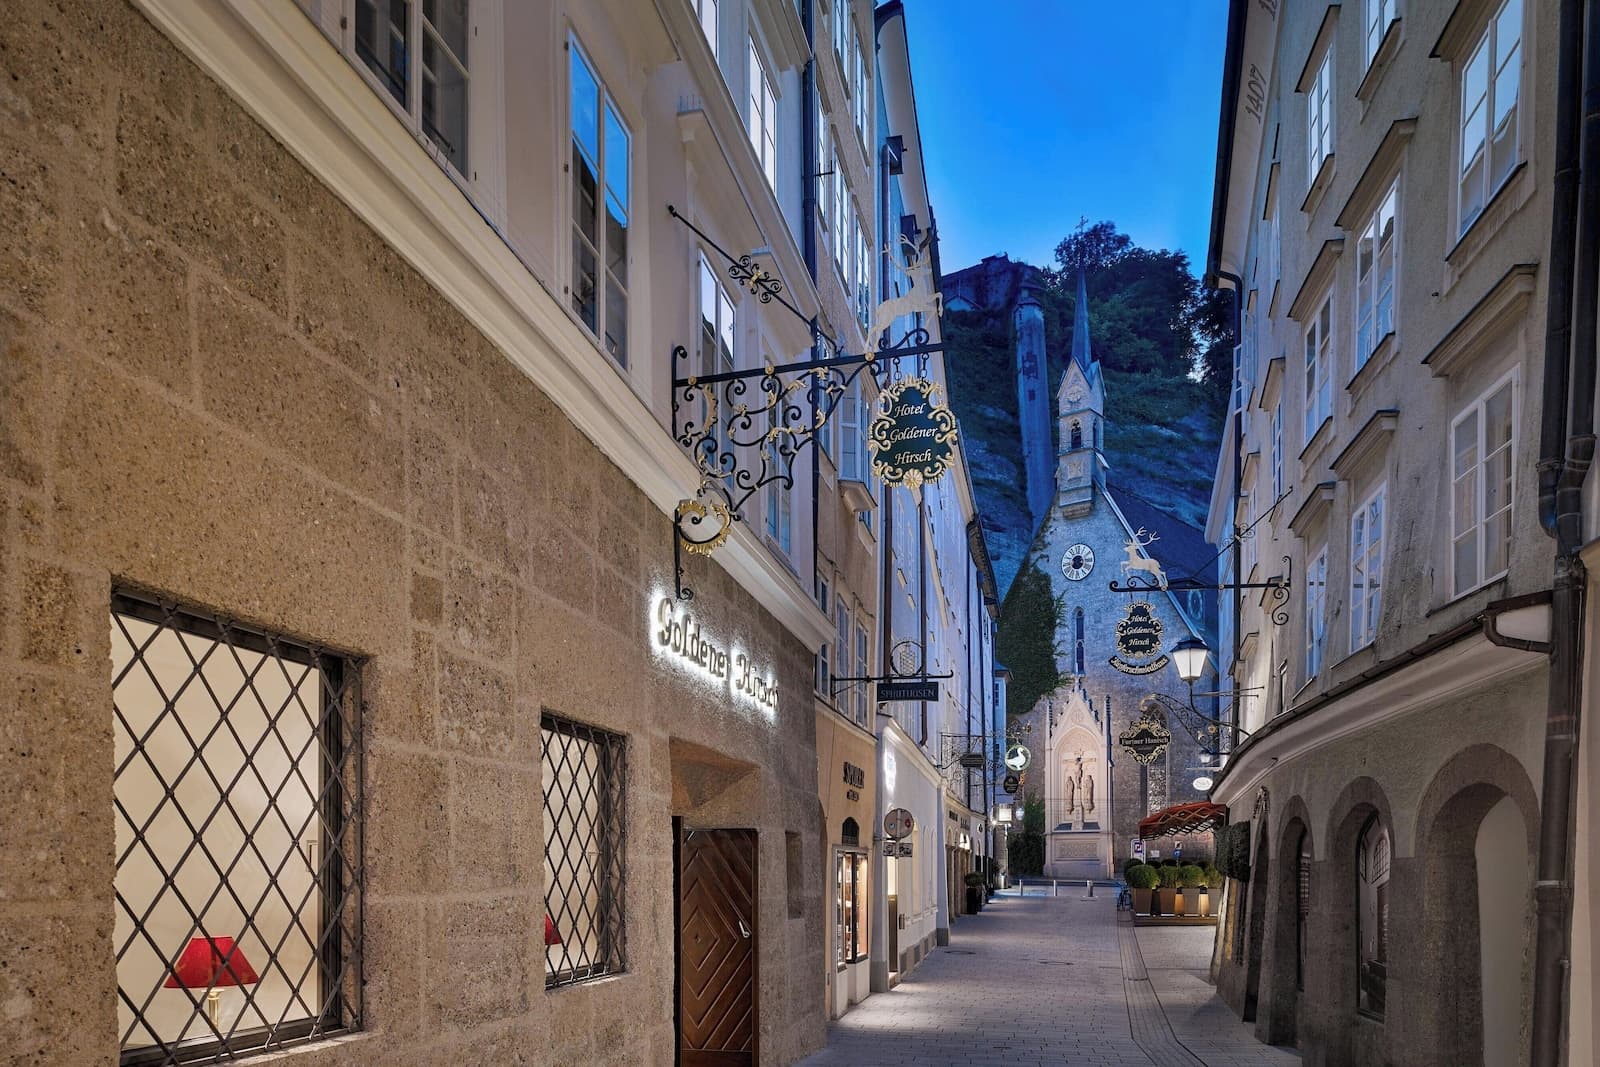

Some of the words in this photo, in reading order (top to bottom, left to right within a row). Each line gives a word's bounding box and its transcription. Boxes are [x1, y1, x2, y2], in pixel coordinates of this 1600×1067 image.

[893, 402, 926, 418] Hotel
[889, 426, 938, 443] Goldener
[894, 448, 932, 465] Hirsch
[657, 597, 731, 680] Goldener
